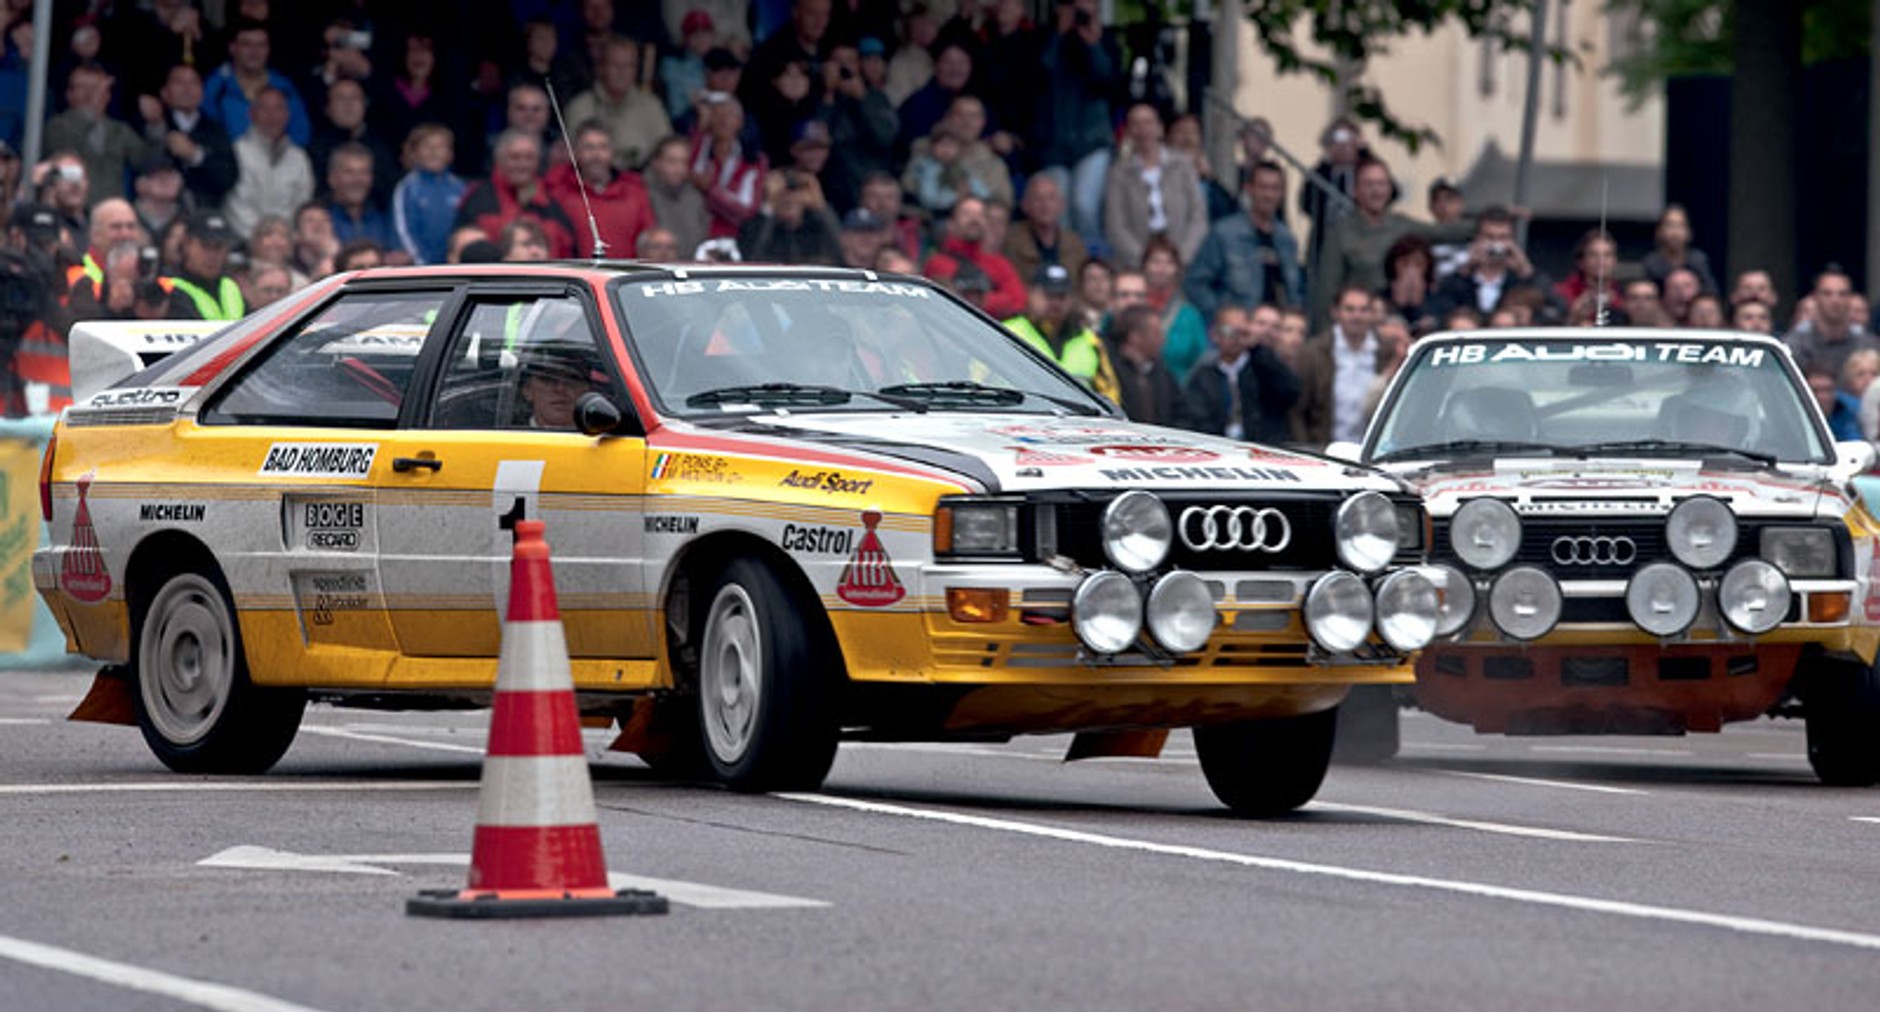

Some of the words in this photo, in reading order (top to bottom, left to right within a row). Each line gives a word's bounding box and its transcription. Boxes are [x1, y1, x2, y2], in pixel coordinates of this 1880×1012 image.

[642, 281, 704, 297] HB
[808, 280, 930, 299] TEAM
[1431, 345, 1486, 366] HB
[1490, 343, 1646, 361] AUDI
[1654, 343, 1765, 368] TEAM
[91, 389, 180, 407] quattro
[263, 448, 300, 471] BAD
[295, 448, 374, 473] HOMBURG
[779, 469, 825, 489] Audi
[821, 472, 874, 494] Sport
[1100, 467, 1302, 483] MICHELIN
[140, 504, 206, 522] MICHELIN
[305, 504, 364, 527] BOGE
[644, 516, 700, 534] MICHELIN
[311, 533, 357, 547] RECARO
[781, 523, 853, 555] Castrol
